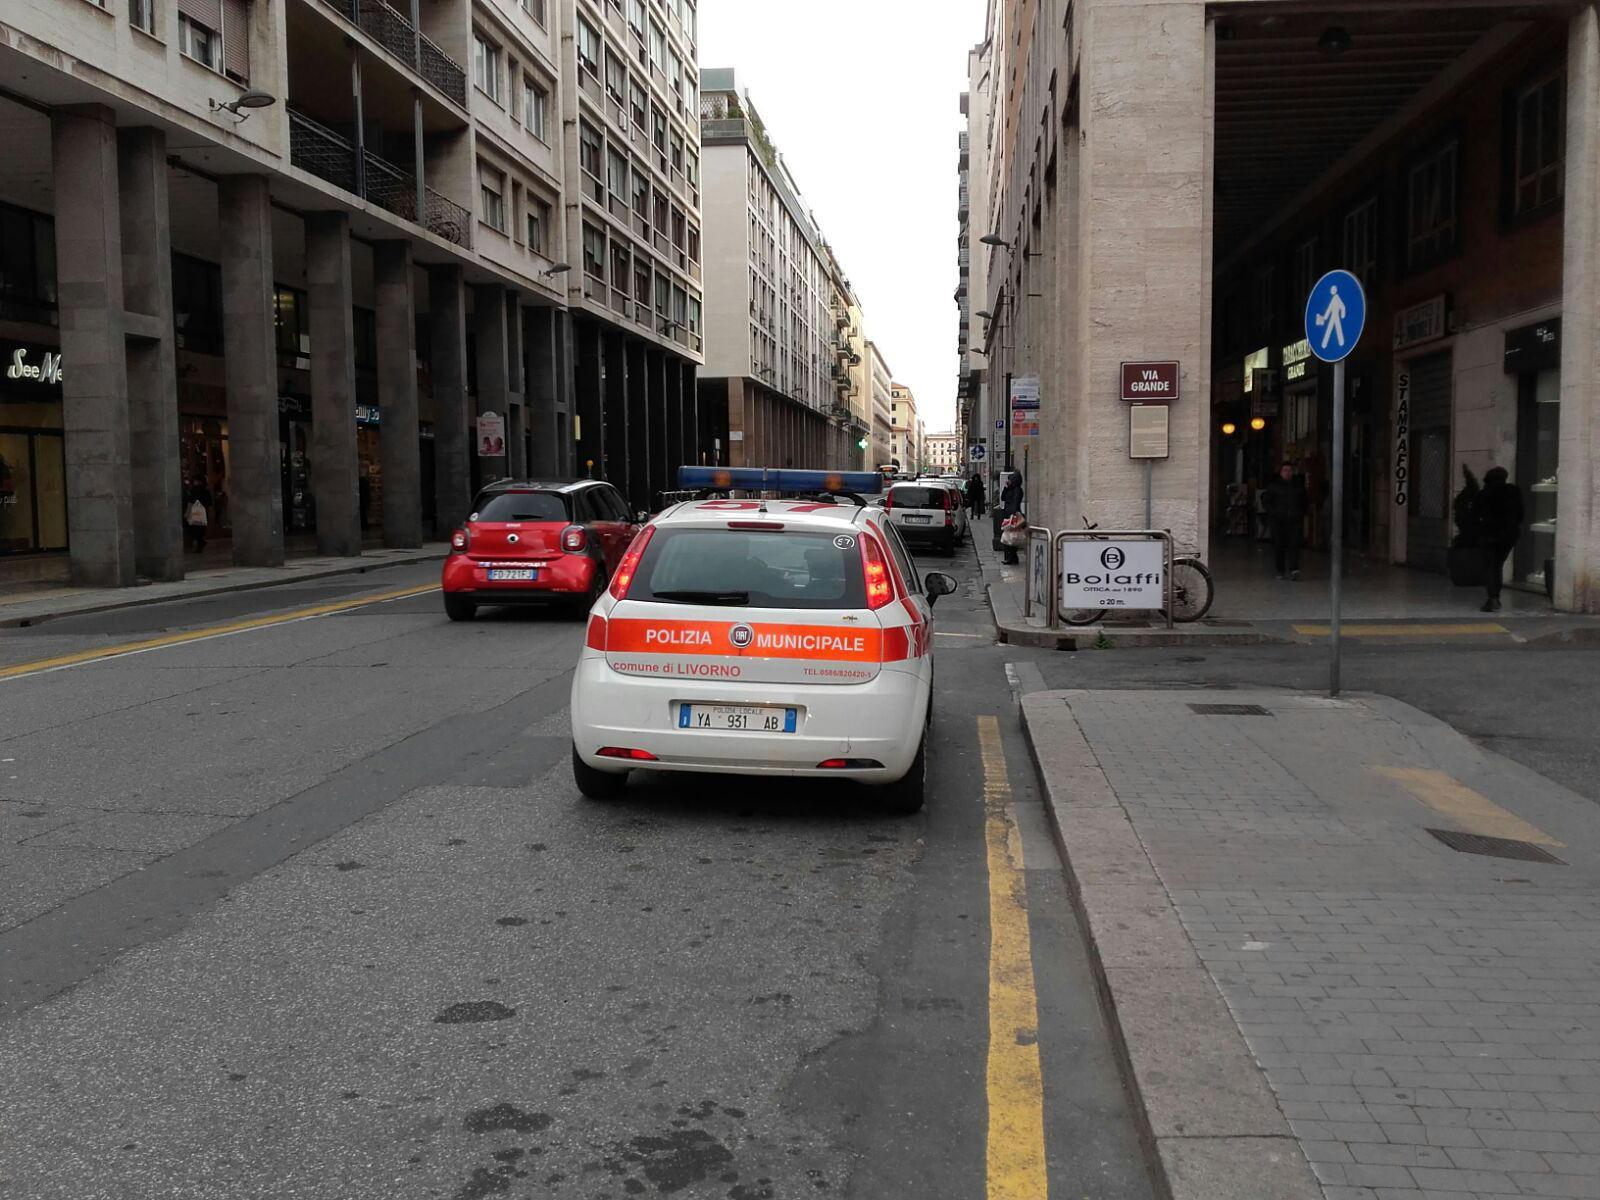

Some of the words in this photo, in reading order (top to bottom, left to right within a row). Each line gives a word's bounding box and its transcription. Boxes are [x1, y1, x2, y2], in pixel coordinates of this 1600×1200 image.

[7, 348, 40, 379] See
[1142, 370, 1159, 380] VIA
[1131, 381, 1170, 392] GRANDE
[1395, 374, 1409, 505] STAMPAFOTO
[836, 538, 851, 547] 57
[1067, 573, 1159, 584] Bolaffi
[646, 629, 712, 645] POLIZIA
[735, 631, 748, 640] FIAT
[757, 634, 864, 652] MUNICIPALE
[613, 662, 659, 673] comune
[663, 662, 674, 673] di
[678, 663, 741, 677] LIVORNO
[697, 713, 711, 727] YA
[727, 715, 747, 728] 931
[764, 717, 779, 729] AB
